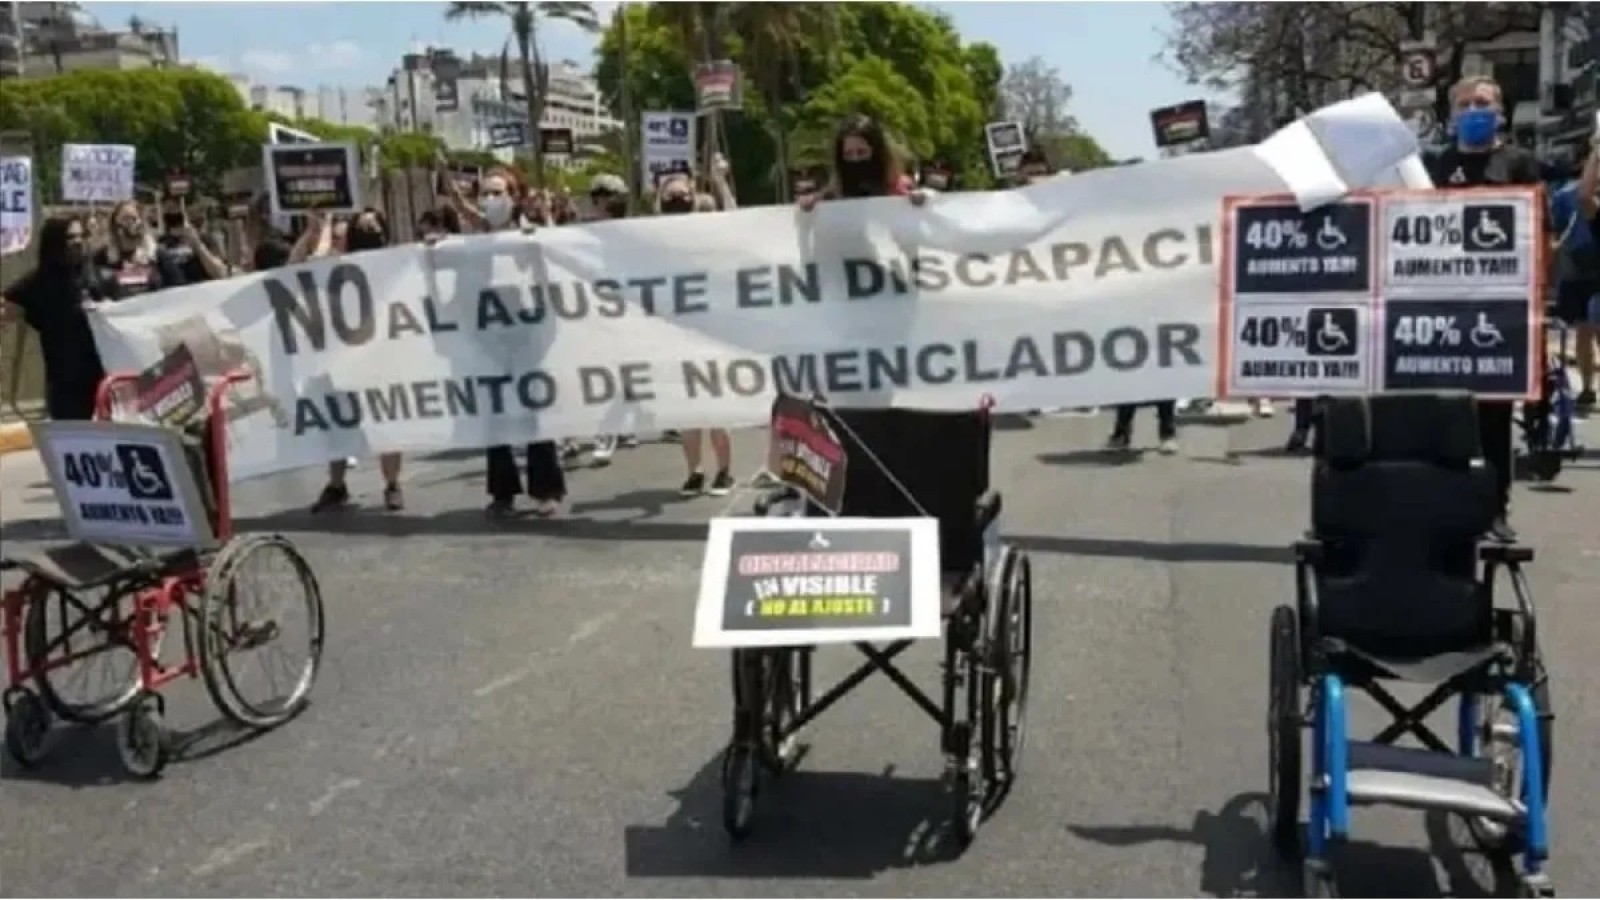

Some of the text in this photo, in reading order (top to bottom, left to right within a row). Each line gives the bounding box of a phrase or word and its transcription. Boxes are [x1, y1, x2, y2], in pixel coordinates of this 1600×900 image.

[1246, 220, 1307, 249] 40%
[1392, 215, 1461, 246] 40%
[1248, 257, 1319, 276] AUMENTO
[1394, 258, 1476, 276] AUMENTO
[264, 263, 376, 356] NO
[388, 298, 457, 340] AL
[477, 272, 708, 331] AJUSTE
[736, 263, 821, 308] EN
[1240, 317, 1306, 347] 40%
[1394, 316, 1461, 346] 40%
[294, 322, 1204, 436] AUMENTO DE NOMENCLADOR
[1241, 360, 1319, 379] AUMENTO
[1395, 356, 1472, 374] AUMENTO
[64, 452, 127, 489] 40%
